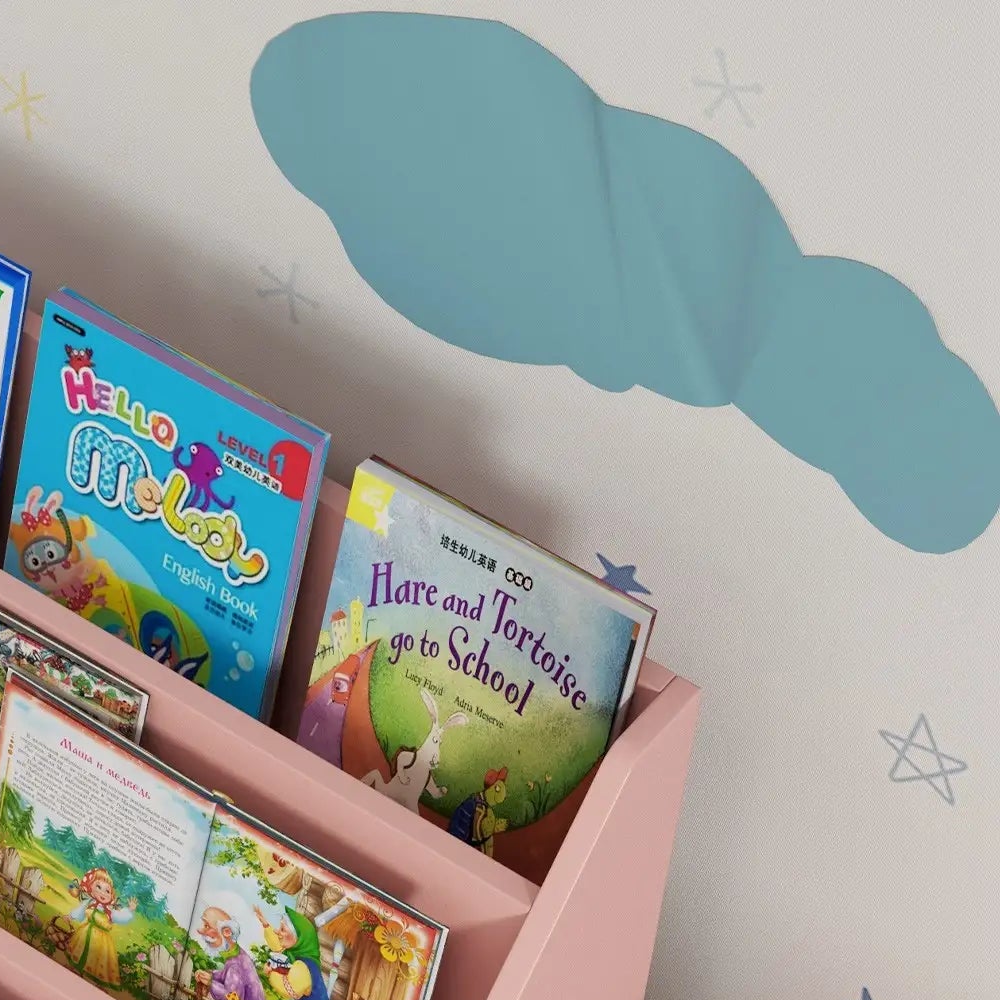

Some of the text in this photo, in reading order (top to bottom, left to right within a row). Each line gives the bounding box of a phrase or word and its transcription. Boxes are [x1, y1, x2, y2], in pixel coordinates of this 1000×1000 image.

[63, 369, 176, 448] HELLO
[217, 430, 285, 477] LEVEL 1
[440, 533, 497, 573] 培生幼儿英语
[162, 552, 215, 597] English
[220, 588, 259, 622] Book
[367, 560, 588, 711] Hare and Tortoise
[388, 625, 535, 716] go to School
[405, 668, 444, 696] Lucy Floyd
[454, 696, 504, 729] Adria Meserve
[59, 738, 93, 765] Маша
[96, 761, 103, 770] и
